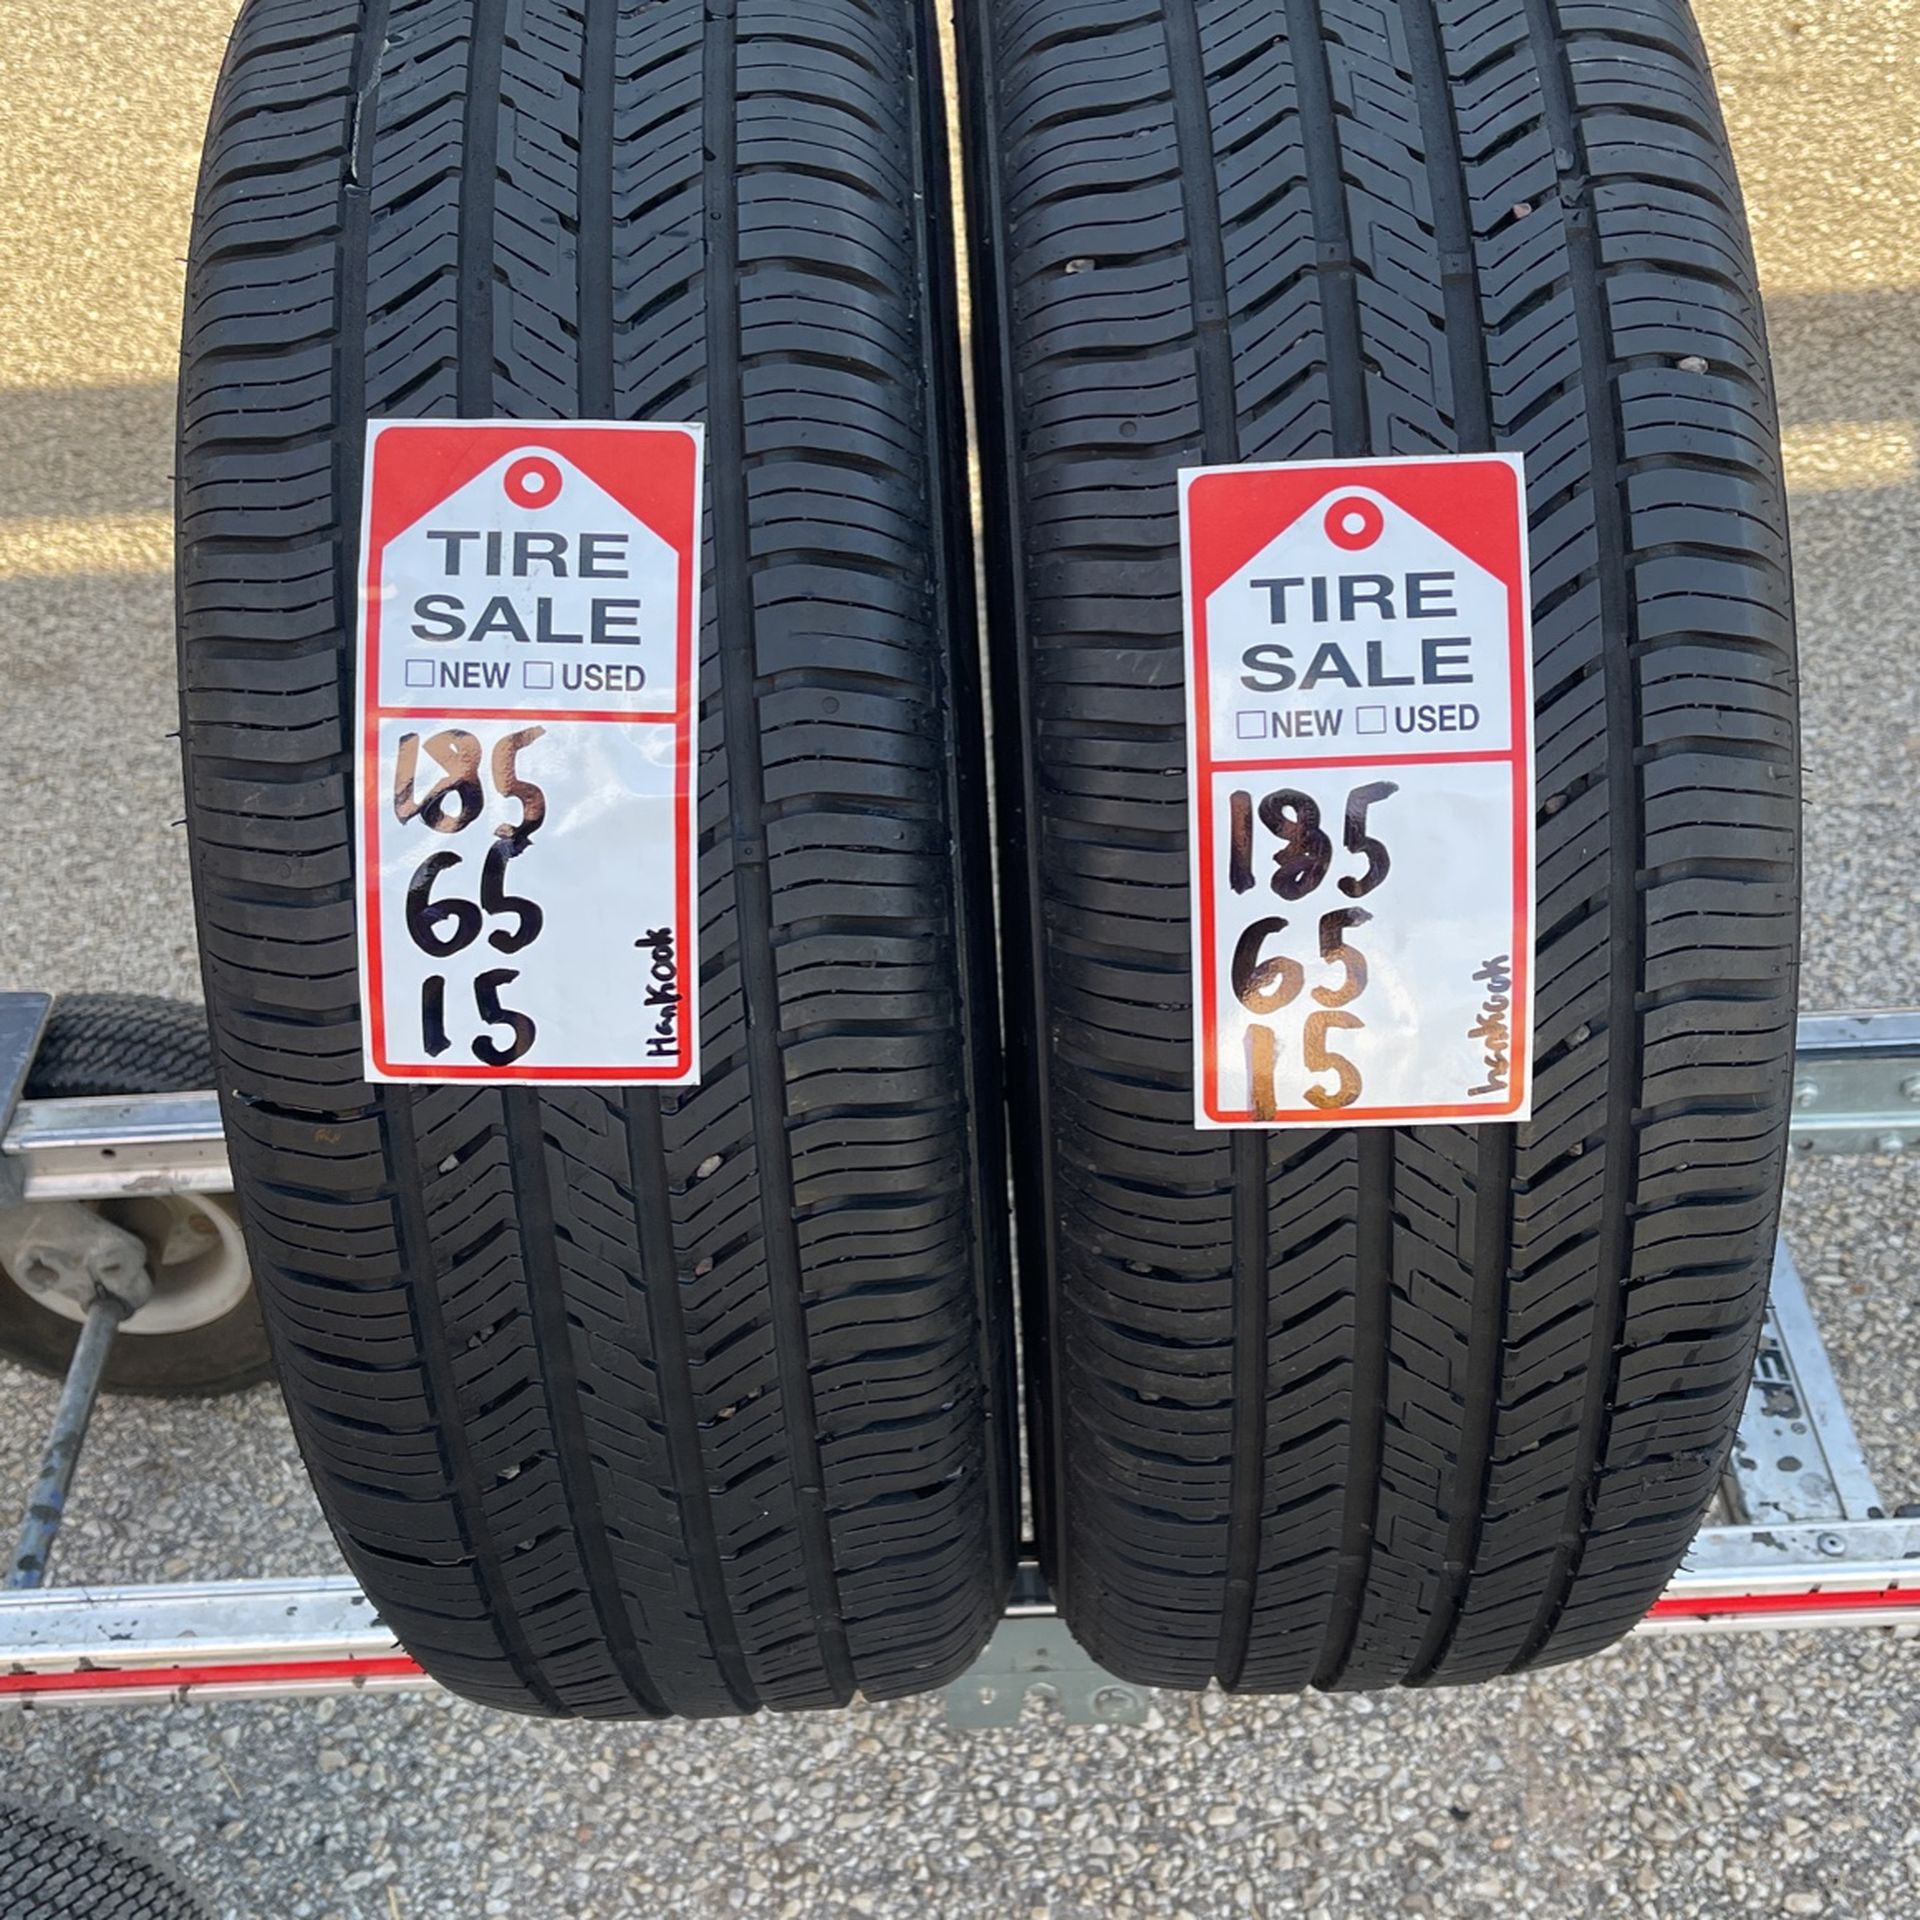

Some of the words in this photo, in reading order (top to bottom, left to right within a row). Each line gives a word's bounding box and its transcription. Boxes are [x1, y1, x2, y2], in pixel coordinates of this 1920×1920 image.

[426, 530, 629, 579] TIRE
[411, 594, 642, 646] SALE
[1250, 571, 1457, 625] TIRE
[440, 661, 511, 689] NEW
[562, 663, 646, 691] USED
[1240, 637, 1474, 693] SALE
[1271, 708, 1343, 738] NEW
[1395, 704, 1480, 734] USED
[394, 725, 546, 839] 185
[1229, 781, 1399, 901] 185
[405, 838, 543, 958] 65
[1231, 906, 1373, 1015] 65
[421, 968, 537, 1067] 15
[1243, 1010, 1365, 1122] 15
